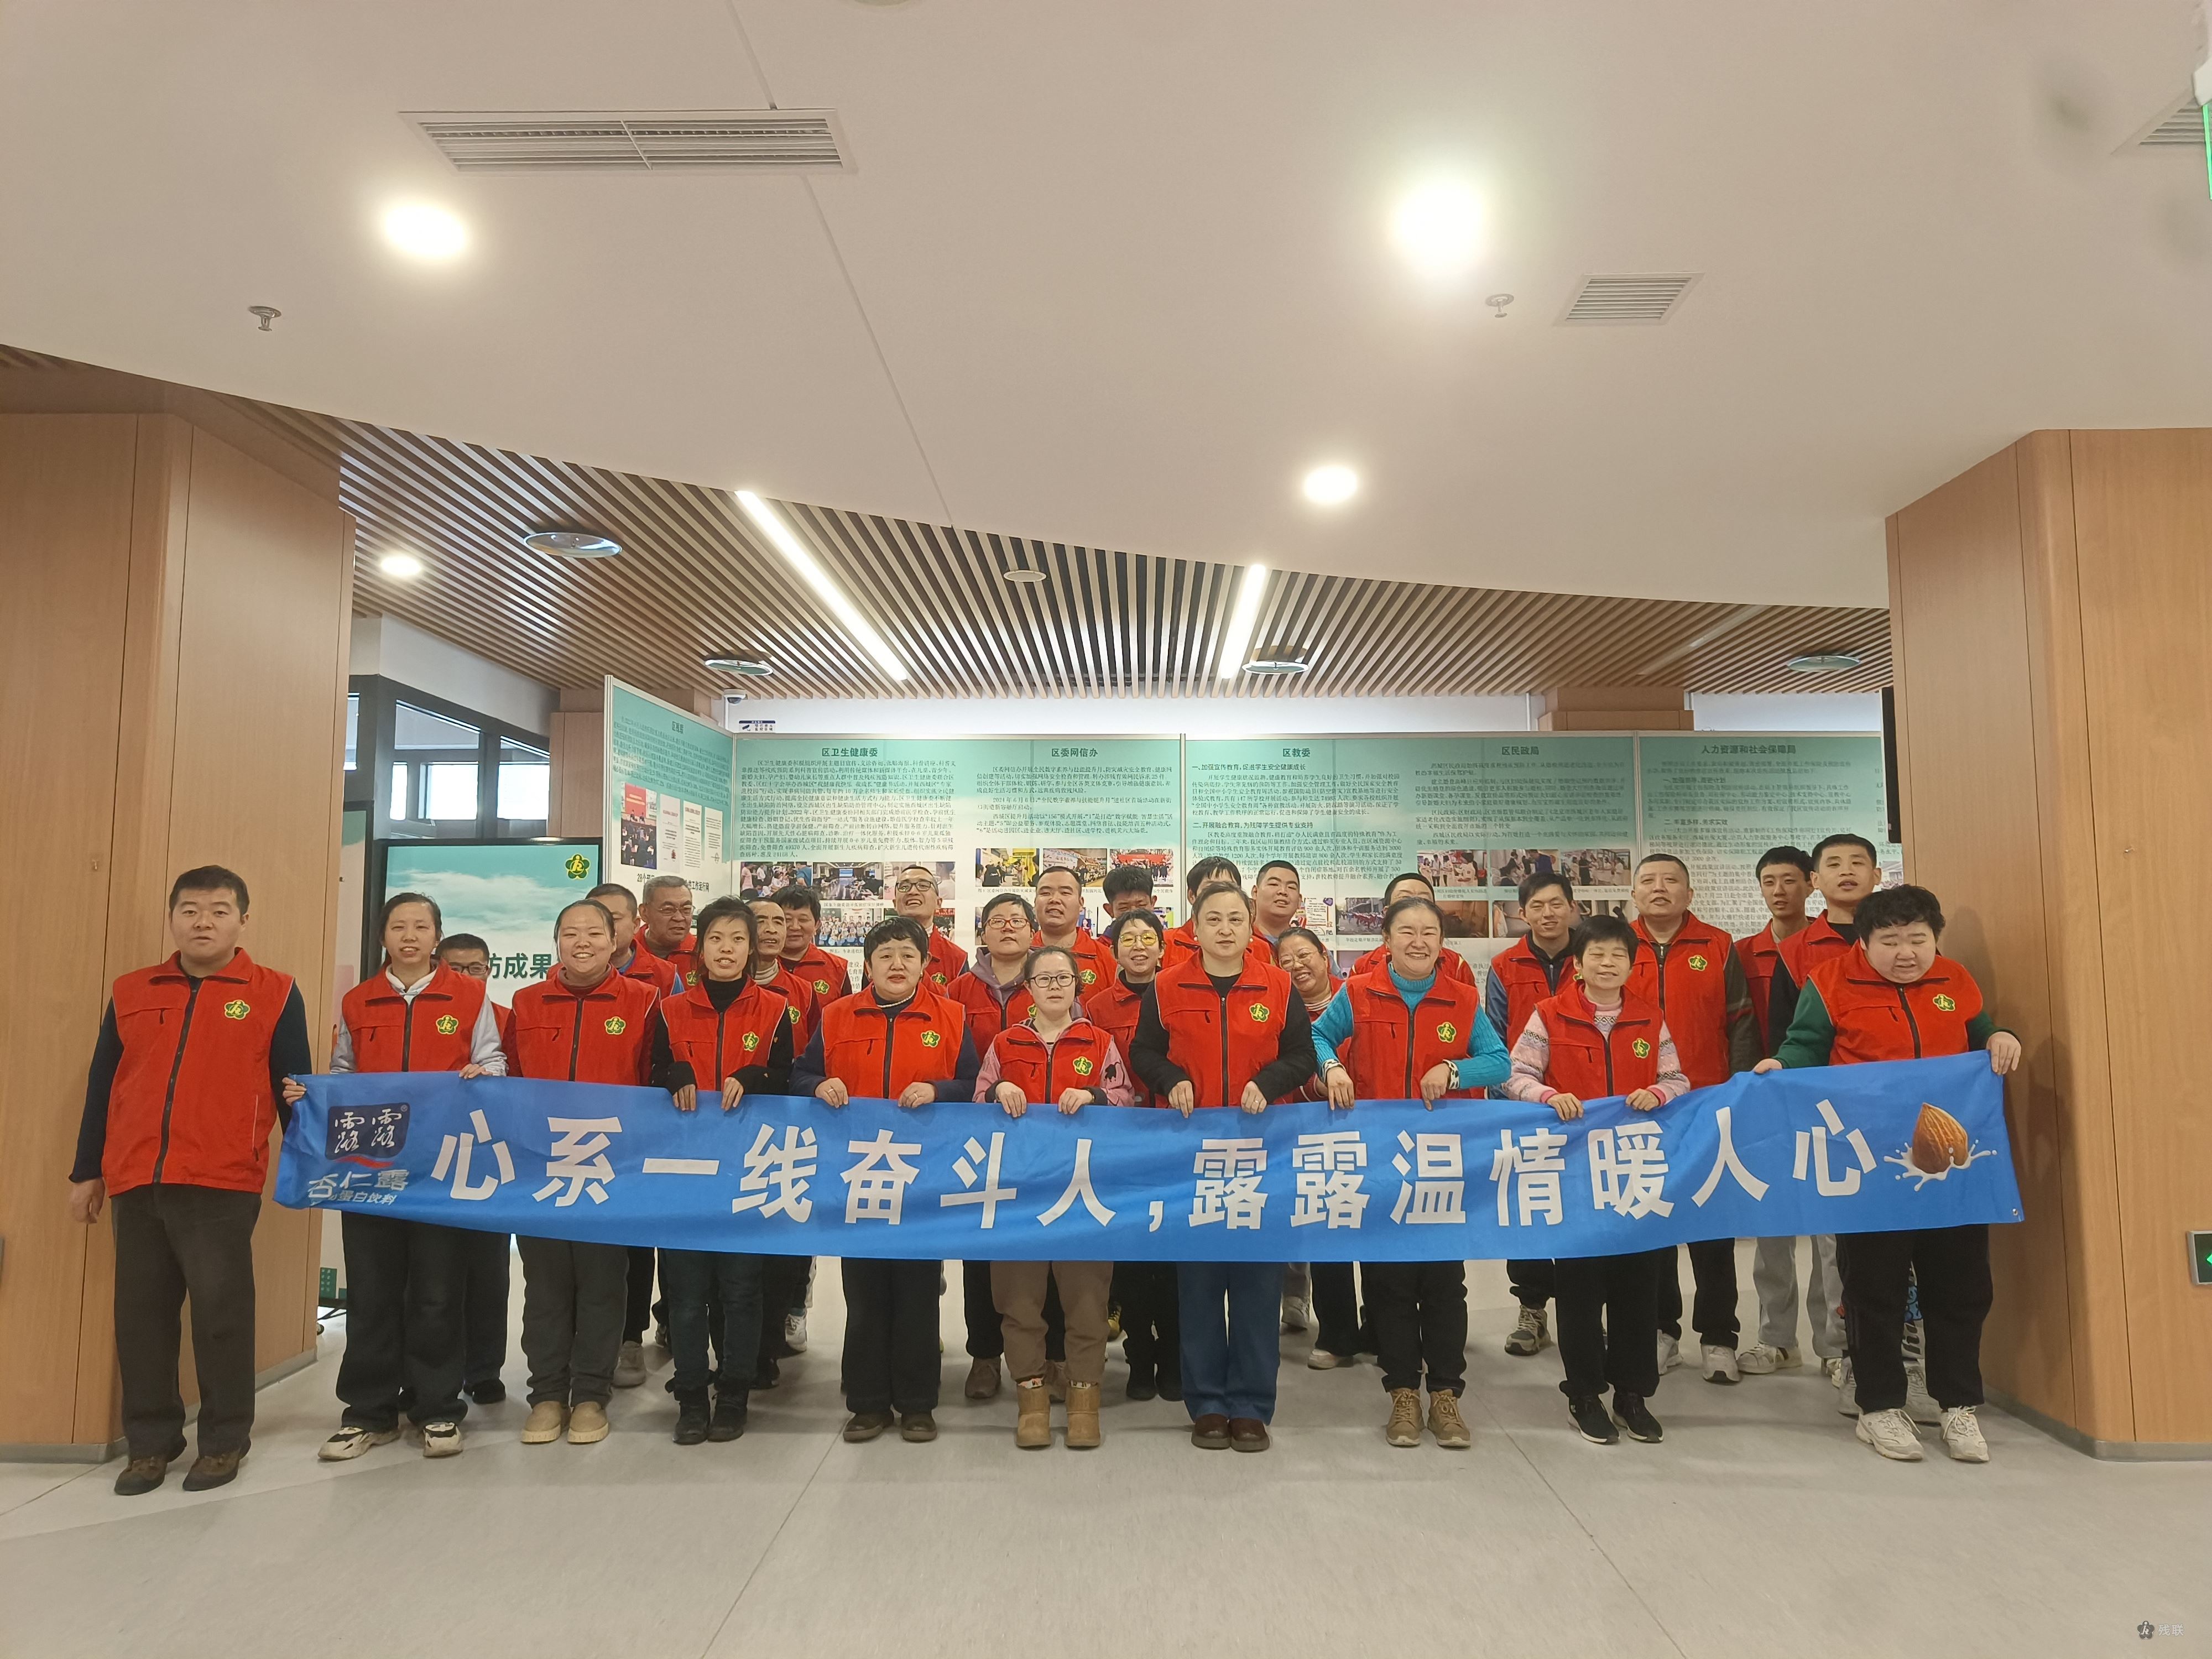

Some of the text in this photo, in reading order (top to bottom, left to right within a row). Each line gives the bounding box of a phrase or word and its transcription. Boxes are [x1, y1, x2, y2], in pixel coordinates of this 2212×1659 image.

[822, 747, 878, 758] 区卫生健康委
[1051, 748, 1098, 758] 区委网信办
[1282, 748, 1311, 758] 区教委
[1501, 746, 1540, 755] 区民政局
[1701, 744, 1796, 754] 人力资源和社会保障局
